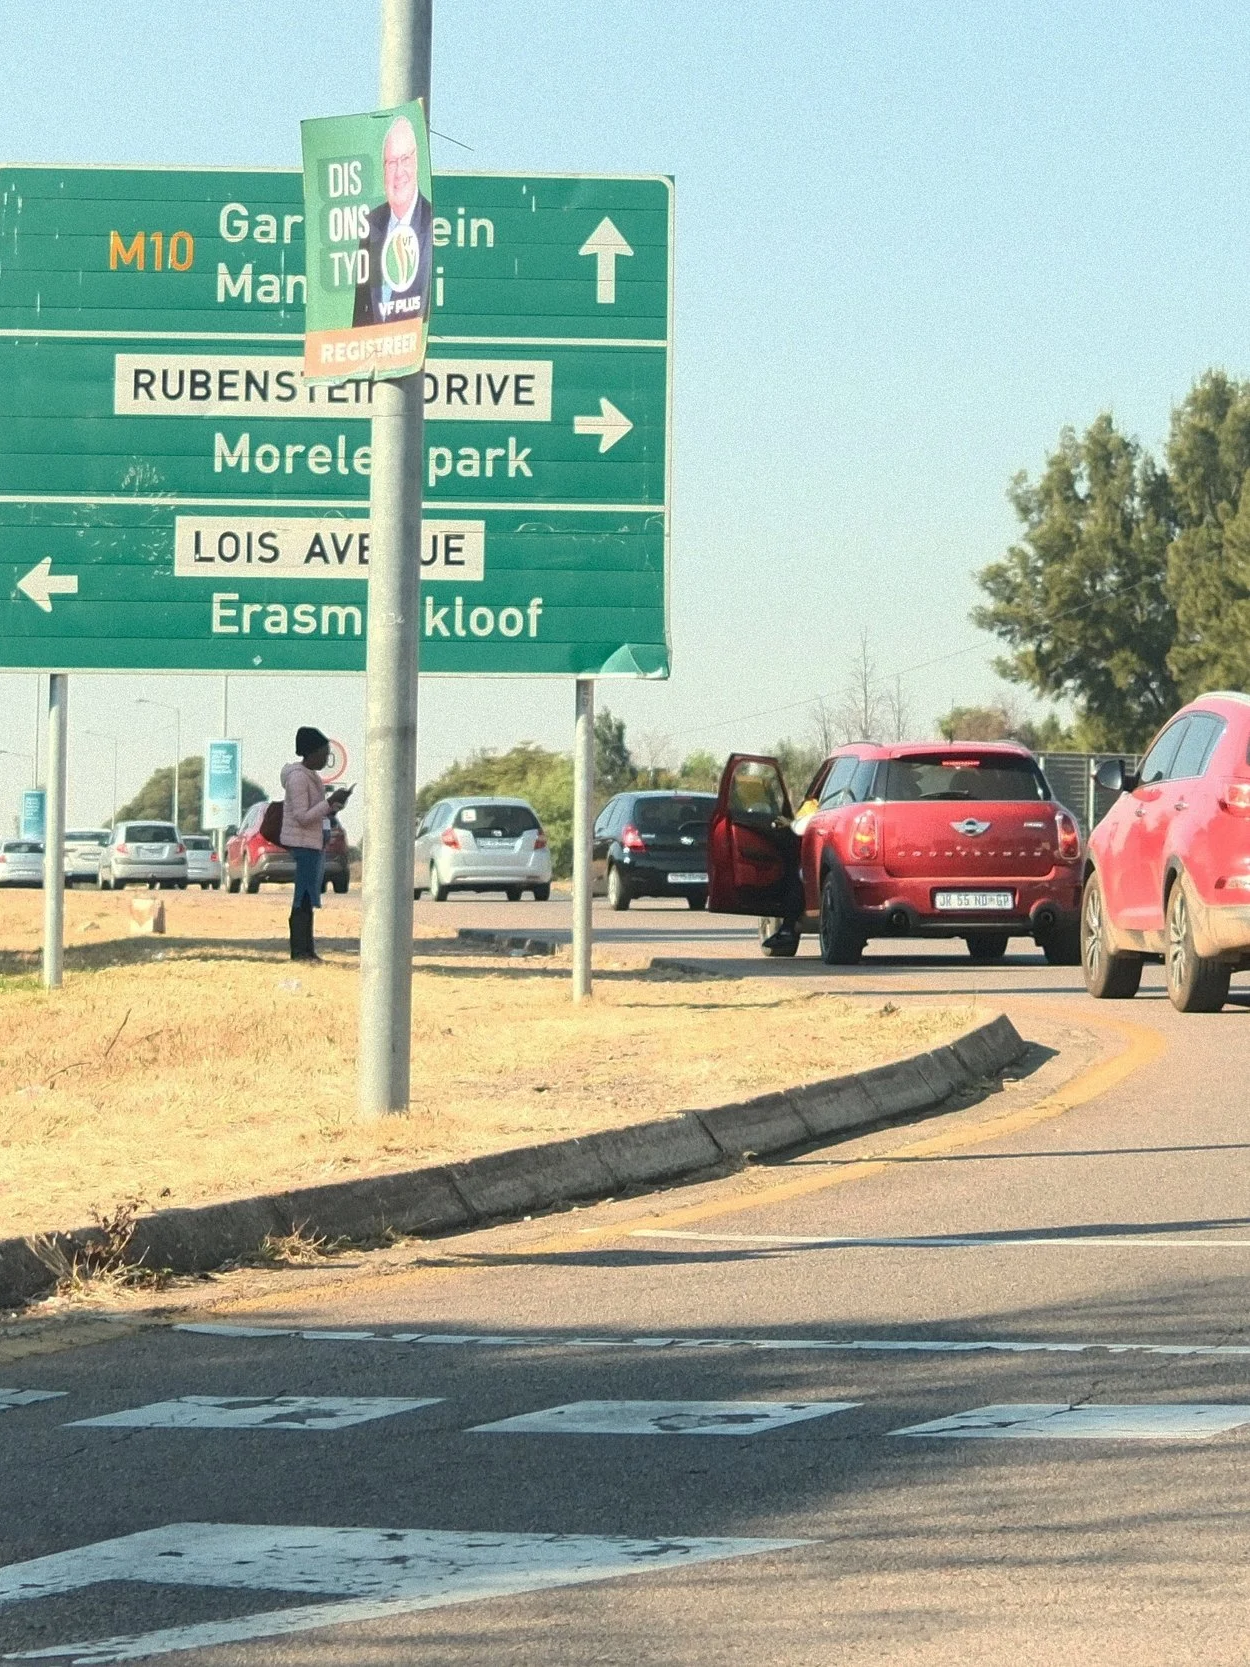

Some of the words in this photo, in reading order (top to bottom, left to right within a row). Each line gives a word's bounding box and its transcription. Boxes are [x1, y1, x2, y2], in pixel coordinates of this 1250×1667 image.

[328, 161, 362, 198] DIS
[329, 203, 371, 242] ONS
[109, 230, 194, 271] M10
[329, 249, 370, 287] TYD
[378, 301, 395, 317] VF
[396, 296, 421, 314] PLUS
[321, 332, 417, 365] REGISTREER
[423, 373, 535, 406] DRIVE
[213, 433, 533, 487] Morelepark
[194, 531, 280, 564] LOIS
[303, 532, 465, 566] AVEUE
[211, 593, 543, 638] Erasmkloof
